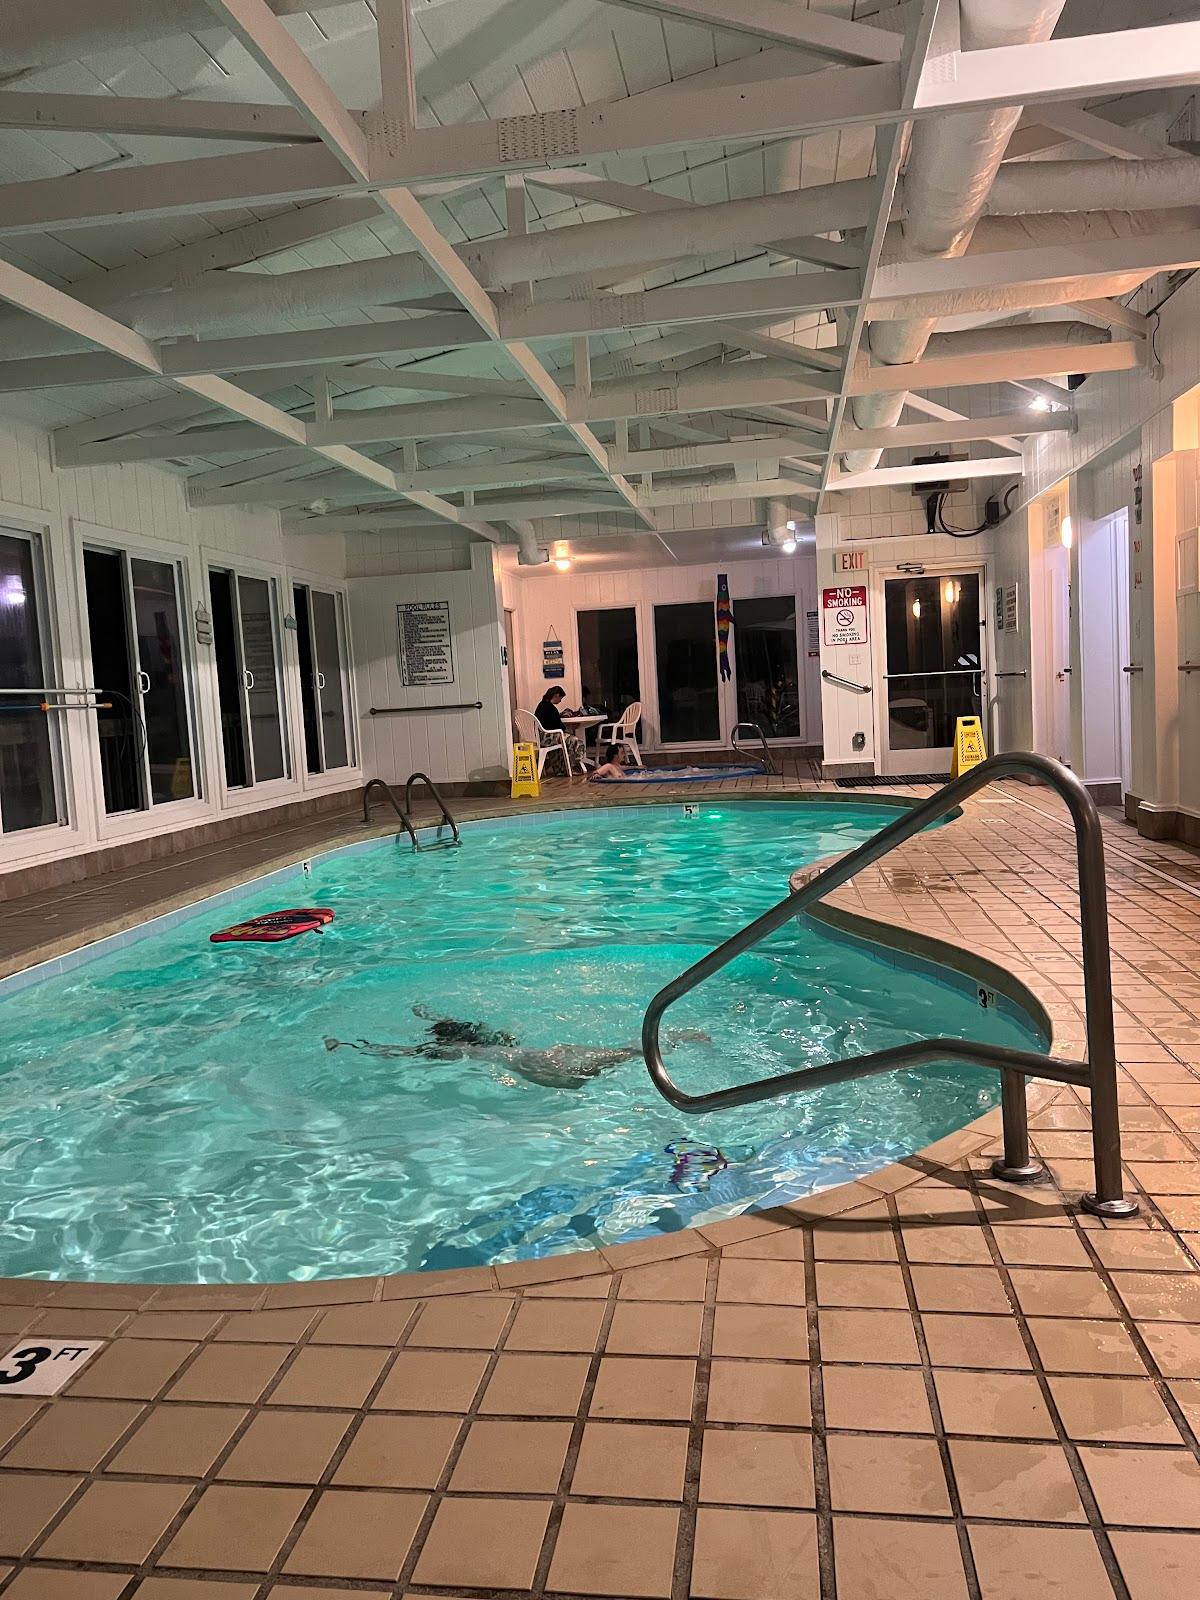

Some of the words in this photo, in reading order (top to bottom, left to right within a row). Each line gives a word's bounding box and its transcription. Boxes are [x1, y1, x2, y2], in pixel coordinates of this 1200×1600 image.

[842, 552, 864, 569] EXIT
[836, 588, 852, 598] NO
[827, 597, 862, 607] SMOKING
[988, 992, 994, 1003] FT
[0, 1346, 52, 1385] 3
[52, 1347, 89, 1361] FT
